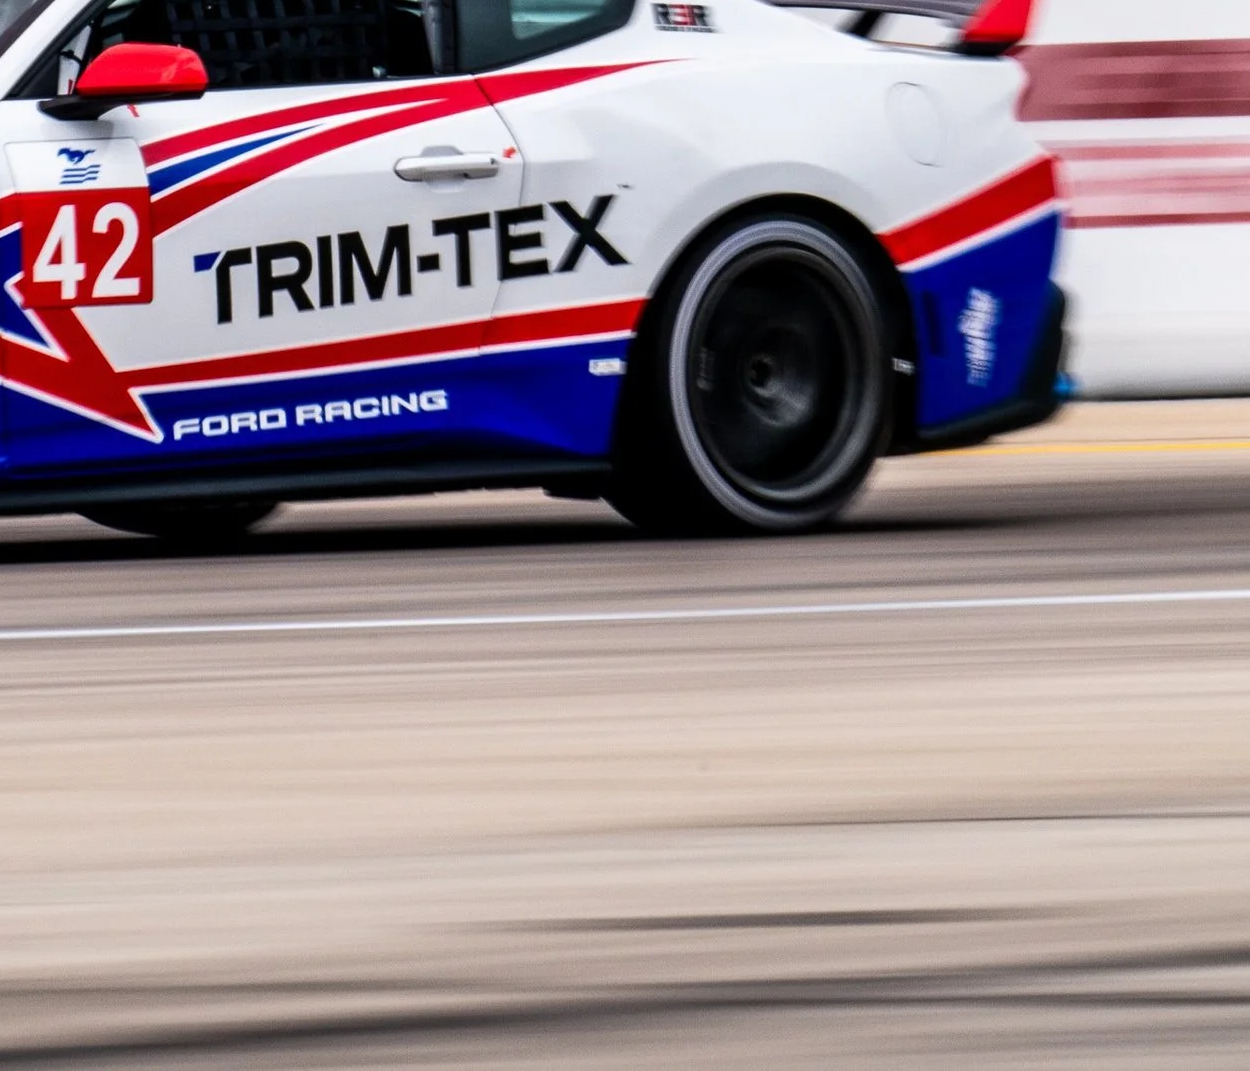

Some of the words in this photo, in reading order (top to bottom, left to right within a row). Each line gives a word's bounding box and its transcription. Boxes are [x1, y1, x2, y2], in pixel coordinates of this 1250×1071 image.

[32, 202, 141, 300] 42
[194, 194, 632, 324] TRIM-TEX
[173, 408, 287, 441] FORD
[295, 389, 448, 426] RACING
